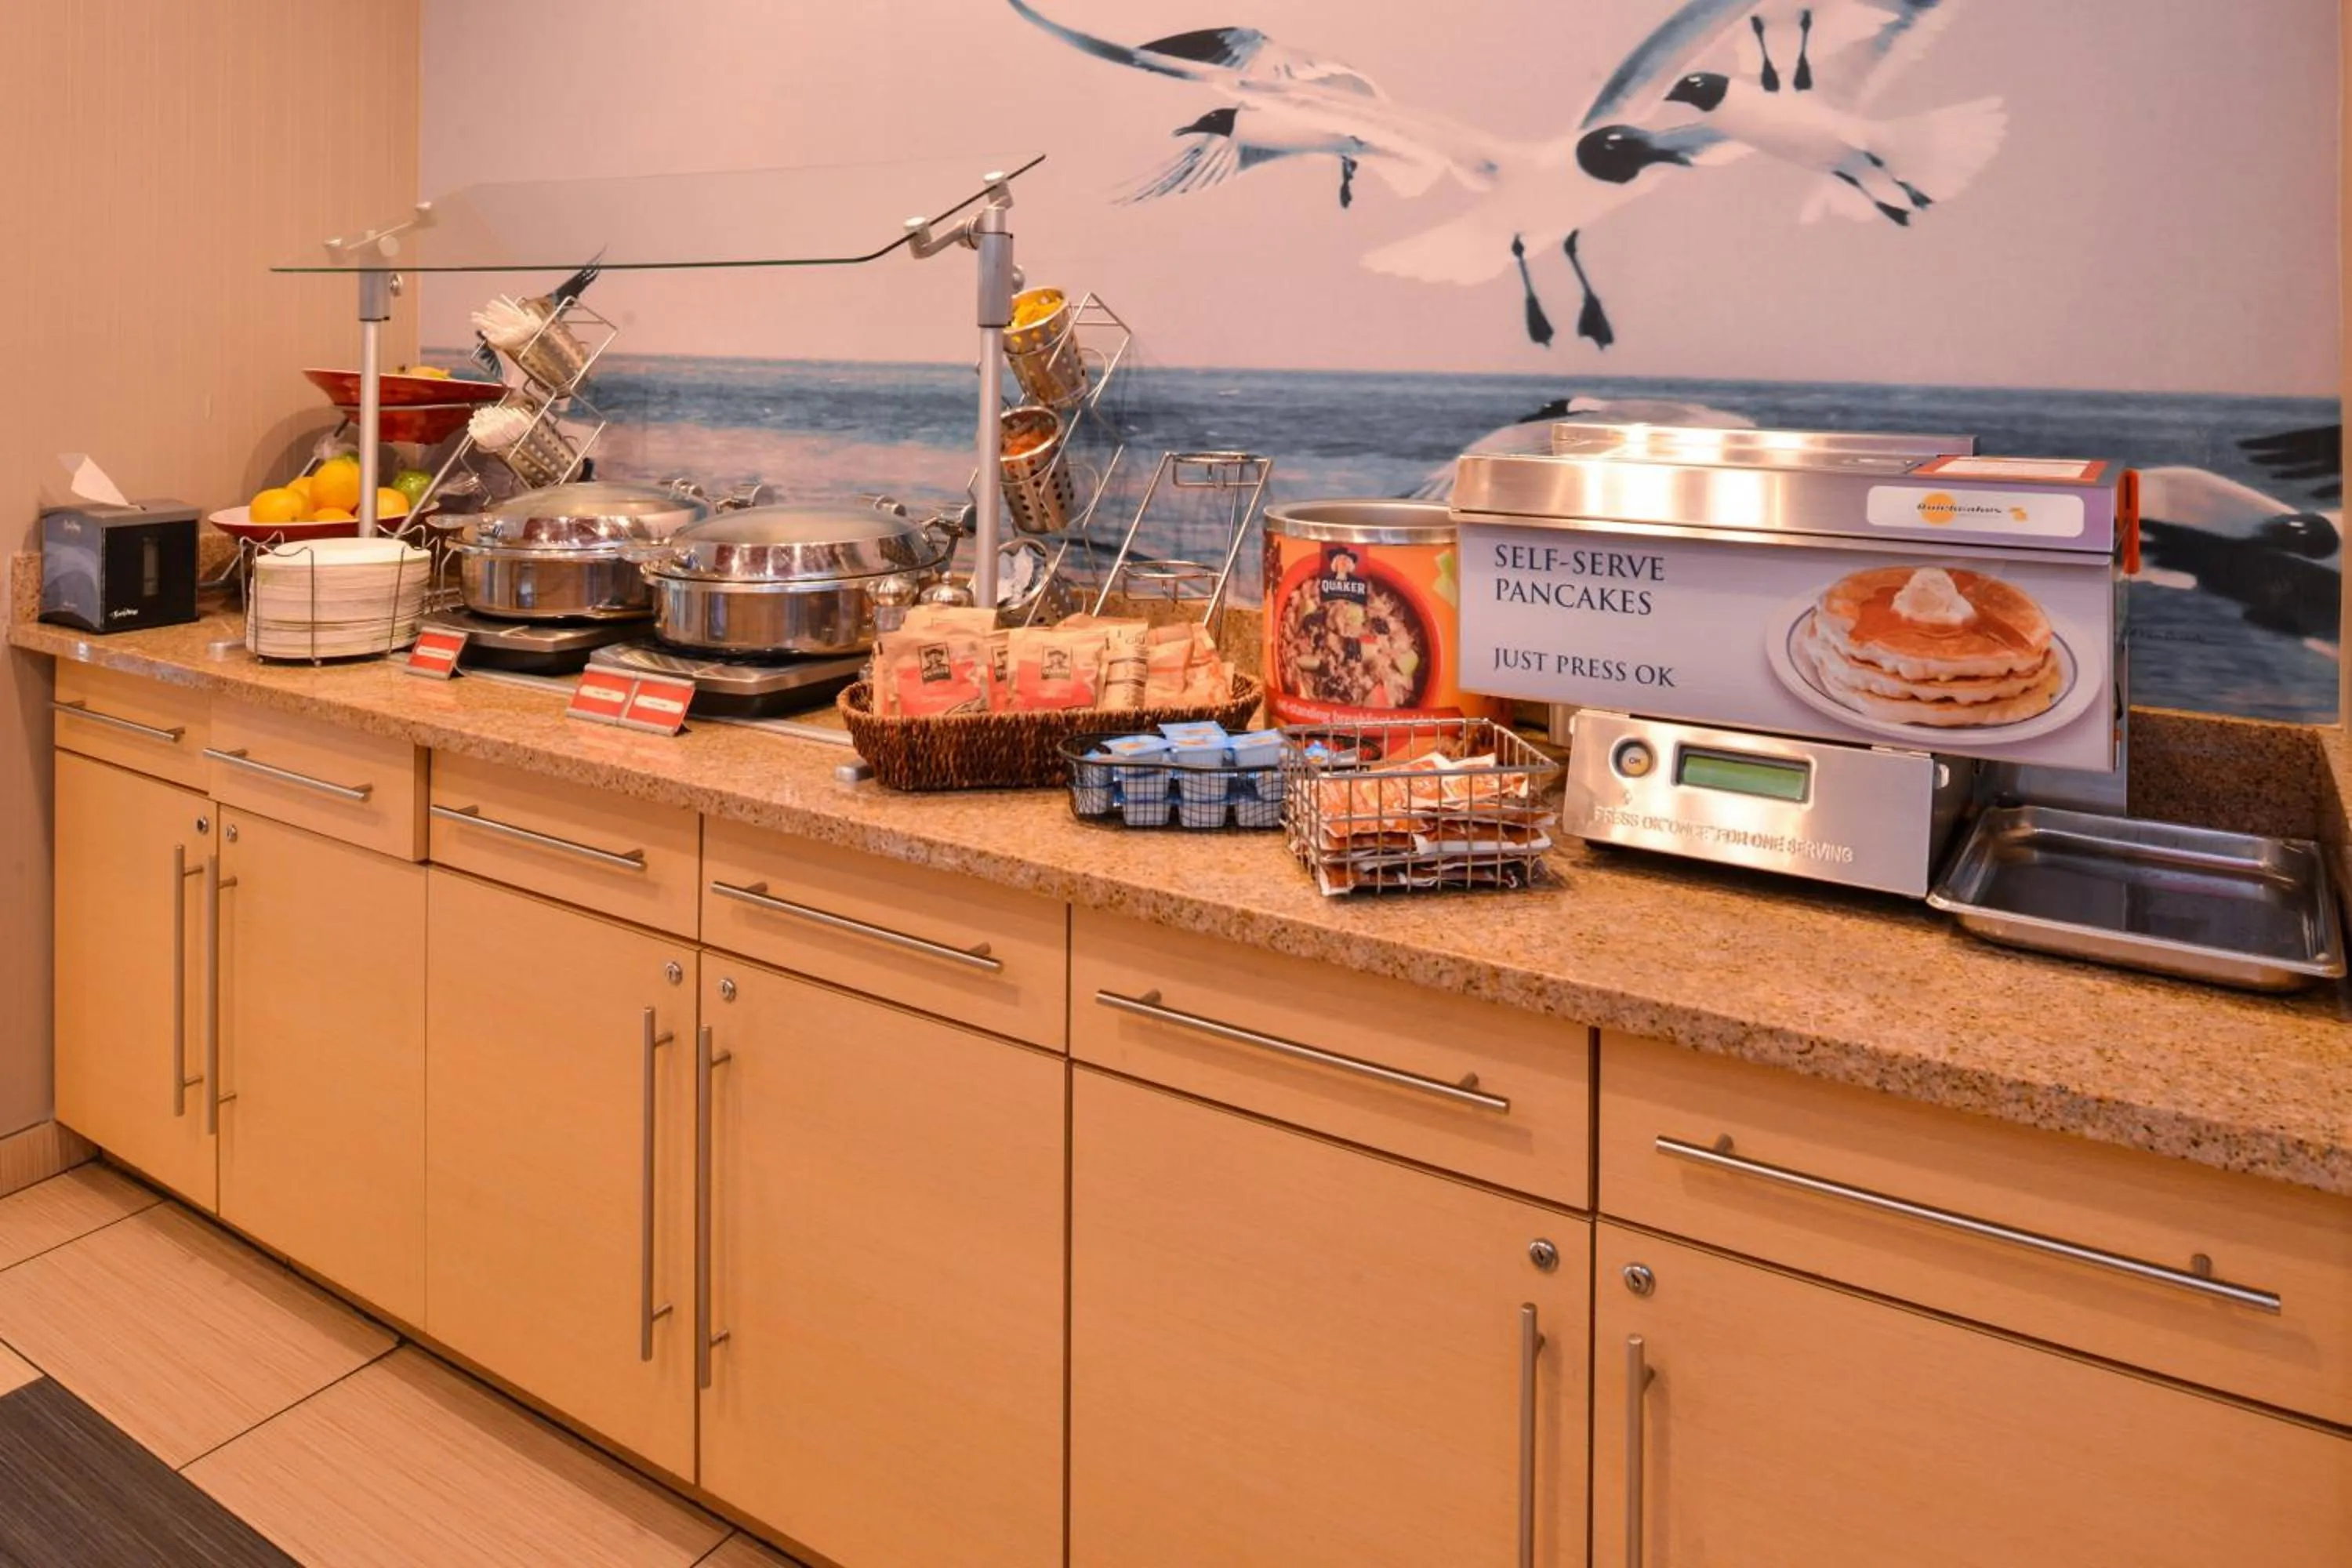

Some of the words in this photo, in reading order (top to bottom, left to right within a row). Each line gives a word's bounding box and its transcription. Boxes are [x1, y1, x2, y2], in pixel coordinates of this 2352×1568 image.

[1494, 543, 1665, 582] SELF-SERVE
[1321, 579, 1366, 595] QUAKER
[1495, 578, 1652, 615] PANCAKES
[1494, 648, 1548, 672] JUST
[1556, 655, 1627, 682] PRESS
[1635, 664, 1676, 688] OK
[1594, 805, 1639, 827] PRESS
[1715, 828, 1748, 847] FOR
[1751, 832, 1785, 853] ONE
[1787, 837, 1853, 863] SERVING
